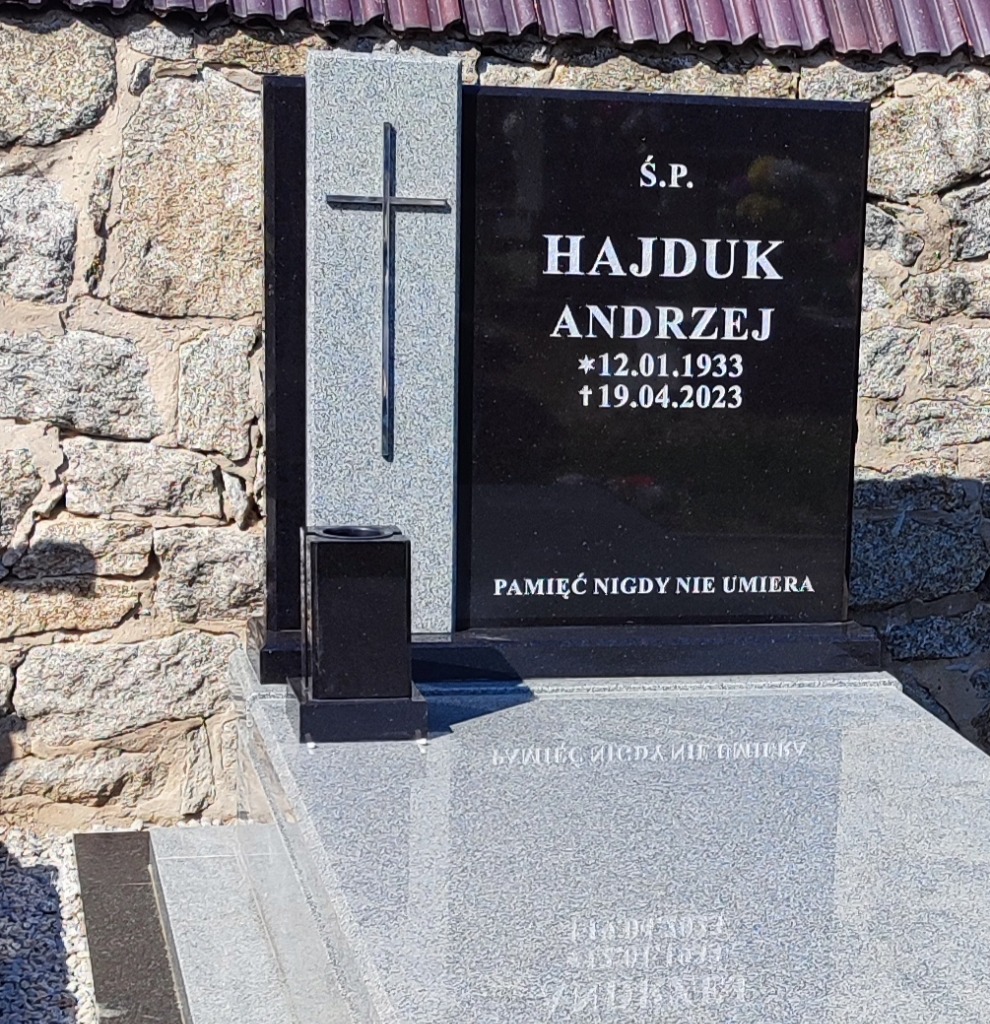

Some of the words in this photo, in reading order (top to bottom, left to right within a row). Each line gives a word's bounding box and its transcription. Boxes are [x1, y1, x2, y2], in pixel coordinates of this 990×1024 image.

[639, 154, 694, 189] Ś.P.
[542, 234, 785, 281] HAJDUK
[549, 304, 776, 342] ANDRZEJ
[493, 572, 588, 600] PAMIĘĆ
[592, 576, 671, 596] NIGDY
[675, 576, 716, 595] NIE
[722, 575, 816, 594] UMIERA
